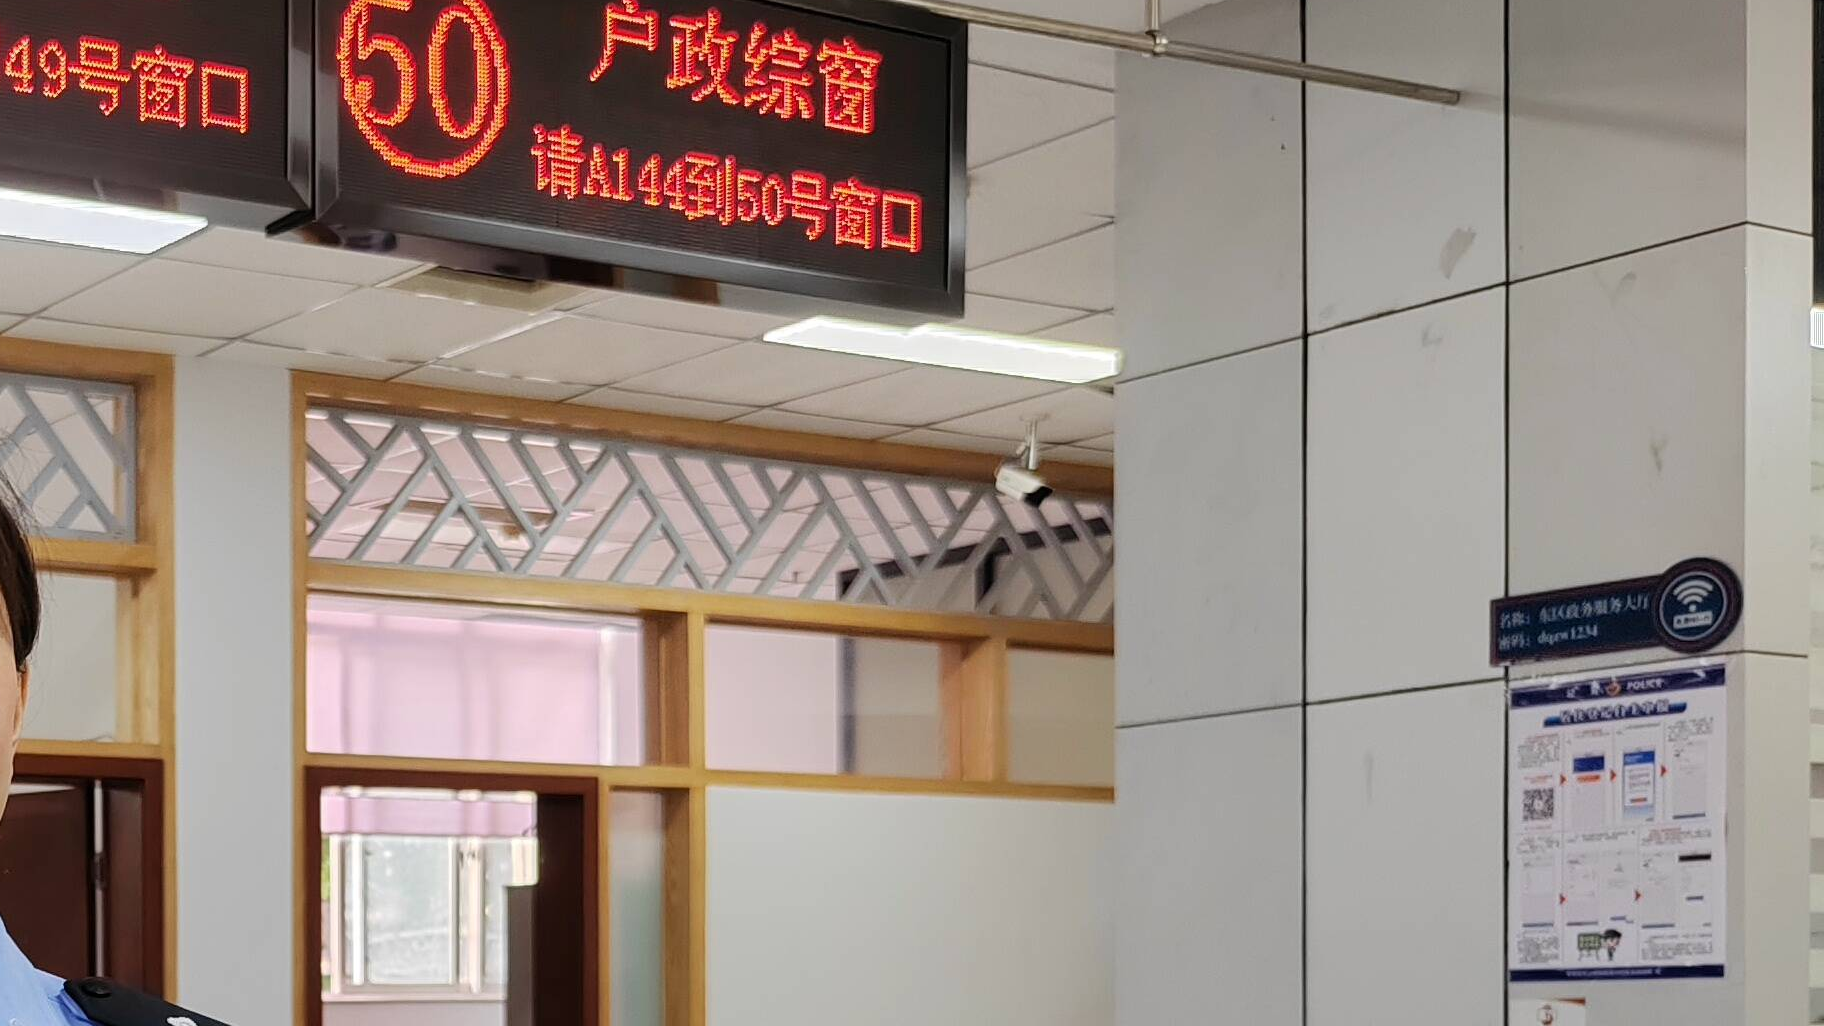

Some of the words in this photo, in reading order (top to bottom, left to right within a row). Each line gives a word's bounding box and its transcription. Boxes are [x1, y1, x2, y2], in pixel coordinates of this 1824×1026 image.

[589, 0, 882, 134] 户政综窗
[531, 124, 923, 253] 请A144到50号窗口
